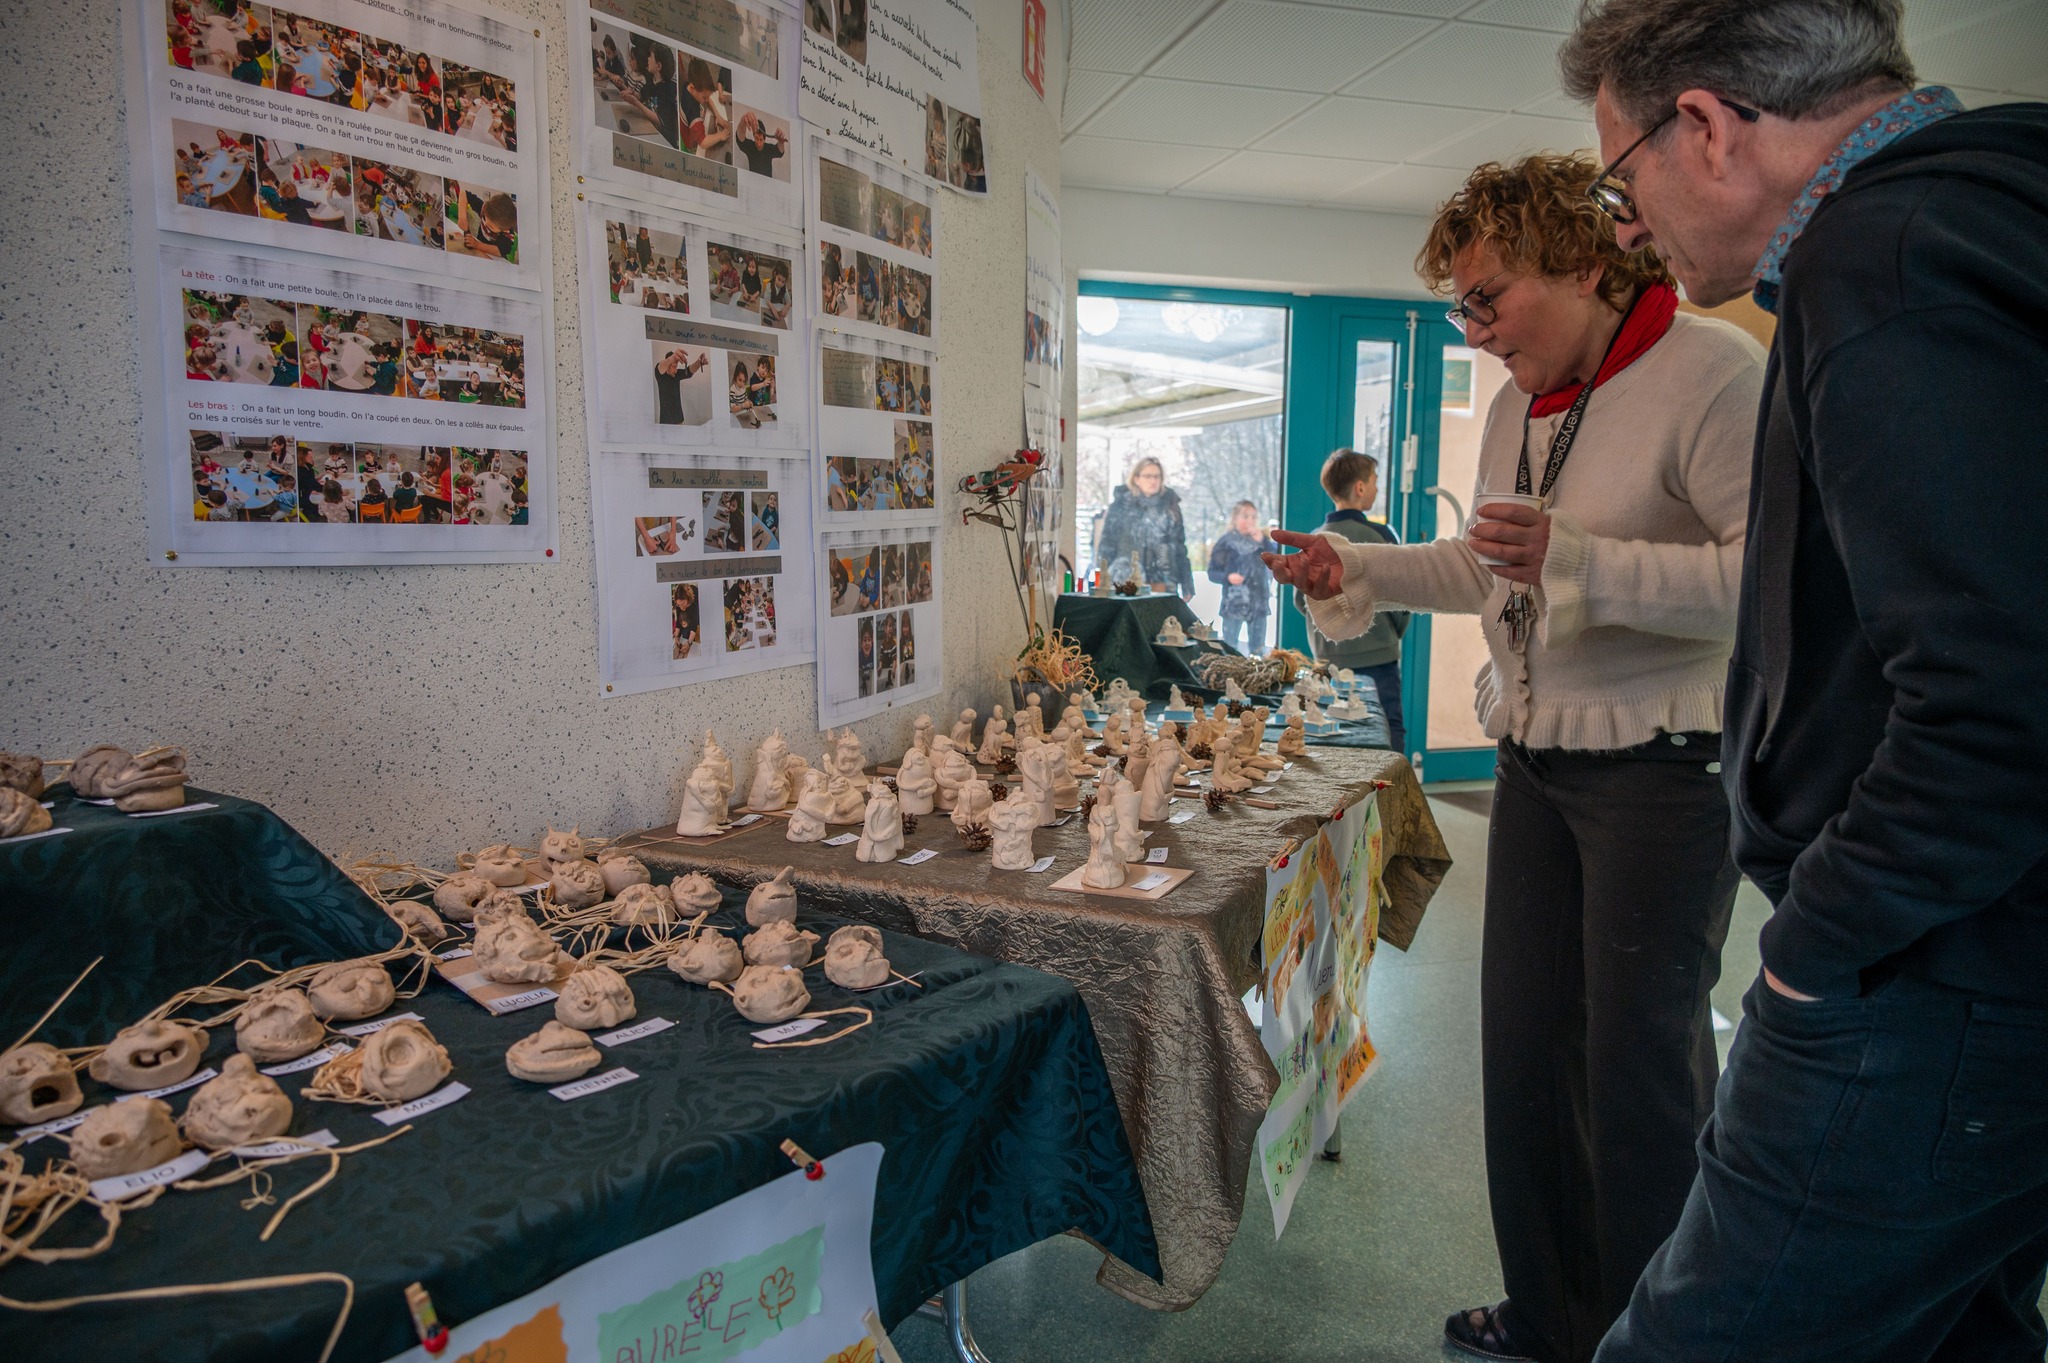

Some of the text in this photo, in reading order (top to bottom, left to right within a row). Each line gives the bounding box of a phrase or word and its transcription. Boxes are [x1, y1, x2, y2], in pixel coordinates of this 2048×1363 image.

[883, 9, 889, 18] a
[403, 9, 415, 19] On
[423, 15, 436, 26] fait
[437, 21, 447, 29] un
[449, 23, 488, 43] bonhomme
[489, 38, 514, 52] debout.
[869, 20, 879, 37] On
[881, 23, 890, 42] les
[890, 38, 896, 46] a
[803, 29, 812, 46] On
[817, 42, 831, 56] mis
[866, 64, 877, 88] fait
[800, 75, 810, 92] On
[811, 86, 816, 95] a
[817, 84, 836, 106] décoré
[169, 79, 184, 90] On
[196, 84, 212, 95] fait
[215, 90, 232, 100] une
[236, 94, 265, 108] grosse
[268, 100, 293, 114] boule
[295, 108, 320, 121] après
[322, 114, 333, 123] on
[334, 114, 344, 125] l'a
[346, 120, 372, 132] roulée
[374, 128, 392, 138] pour
[394, 131, 409, 143] que
[410, 136, 419, 145] ça
[420, 138, 453, 154] devienne
[455, 146, 465, 156] un
[466, 150, 481, 161] gros
[482, 153, 507, 167] boudin.
[509, 161, 518, 170] On
[170, 91, 182, 102] l'a
[185, 95, 216, 109] planté
[218, 98, 251, 117] debout
[253, 111, 268, 120] sur
[270, 113, 279, 123] la
[281, 115, 314, 131] plaque.
[316, 124, 329, 134] On
[338, 129, 352, 140] fait
[354, 134, 365, 143] un
[366, 136, 384, 147] trou
[385, 142, 396, 150] en
[397, 143, 414, 155] haut
[416, 148, 426, 158] du
[427, 152, 454, 165] boudin.
[869, 139, 876, 149] et
[614, 146, 627, 162] On
[630, 154, 636, 162] a
[638, 144, 654, 171] fait
[664, 160, 677, 171] un
[181, 269, 441, 313] La tête On a fait une petite boule. On l'a placée dans le trou.
[188, 400, 205, 409] Les
[207, 401, 228, 411] bras
[241, 403, 255, 413] On
[258, 405, 264, 413] a
[266, 405, 281, 414] fait
[283, 407, 295, 416] un
[297, 408, 316, 419] long
[318, 408, 349, 419] boudin.
[351, 411, 363, 420] On
[365, 412, 374, 421] l'a
[376, 414, 399, 424] coupé
[412, 416, 433, 426] deux.
[435, 418, 446, 426] On
[447, 419, 458, 427] les
[465, 420, 484, 429] collés
[499, 423, 526, 432] épaules.
[188, 412, 203, 421] On
[205, 413, 219, 422] les
[230, 414, 263, 425] croisés
[265, 417, 280, 426] sur
[283, 418, 291, 426] le
[293, 420, 324, 429] ventre.
[652, 471, 664, 485] On
[672, 470, 684, 485] les
[498, 990, 550, 1008] LUCILIA
[614, 1024, 656, 1040] ALICE
[777, 1024, 803, 1036] MIA
[560, 1071, 632, 1096] ETIENNE
[403, 1095, 445, 1114] MAE
[123, 1166, 176, 1188] ELIO
